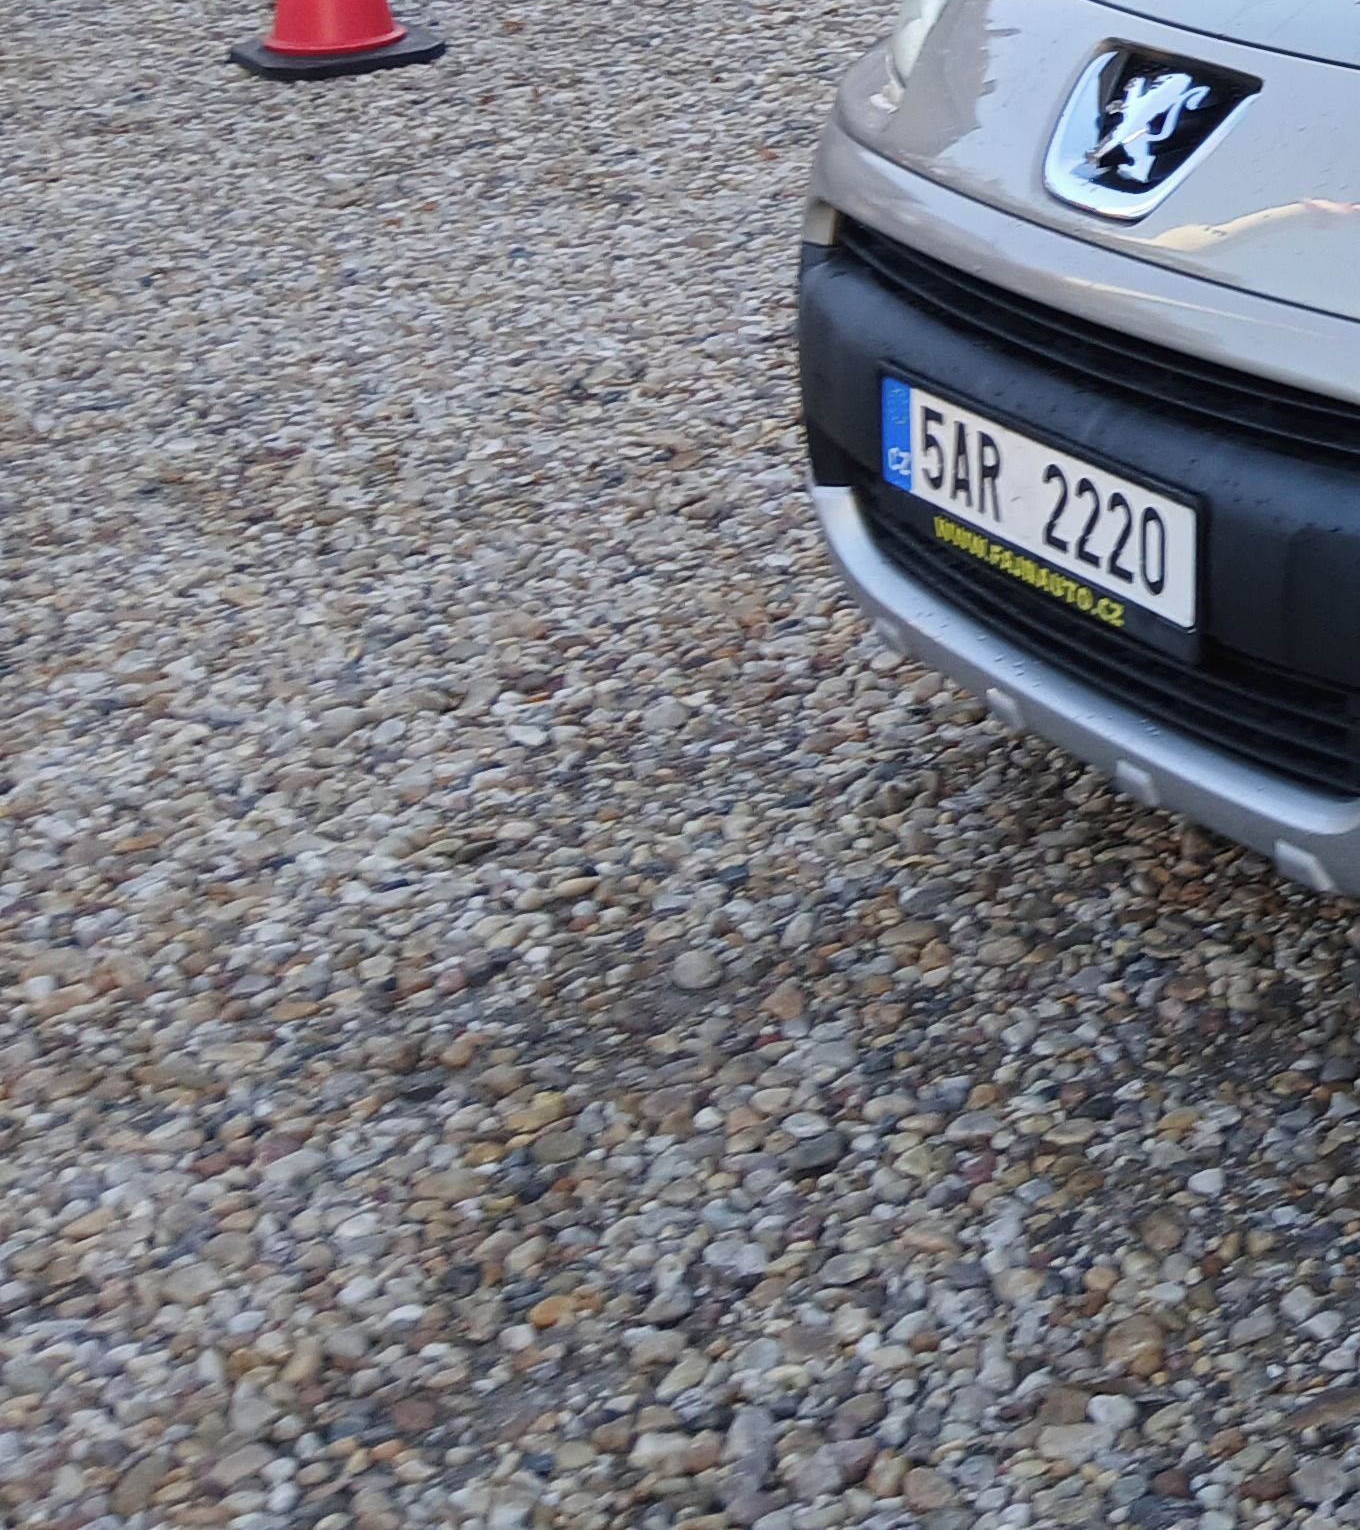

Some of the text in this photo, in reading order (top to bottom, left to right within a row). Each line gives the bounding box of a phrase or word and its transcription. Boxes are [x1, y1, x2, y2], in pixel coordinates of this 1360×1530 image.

[887, 446, 911, 476] CZ
[920, 405, 1166, 596] 5AR 2220
